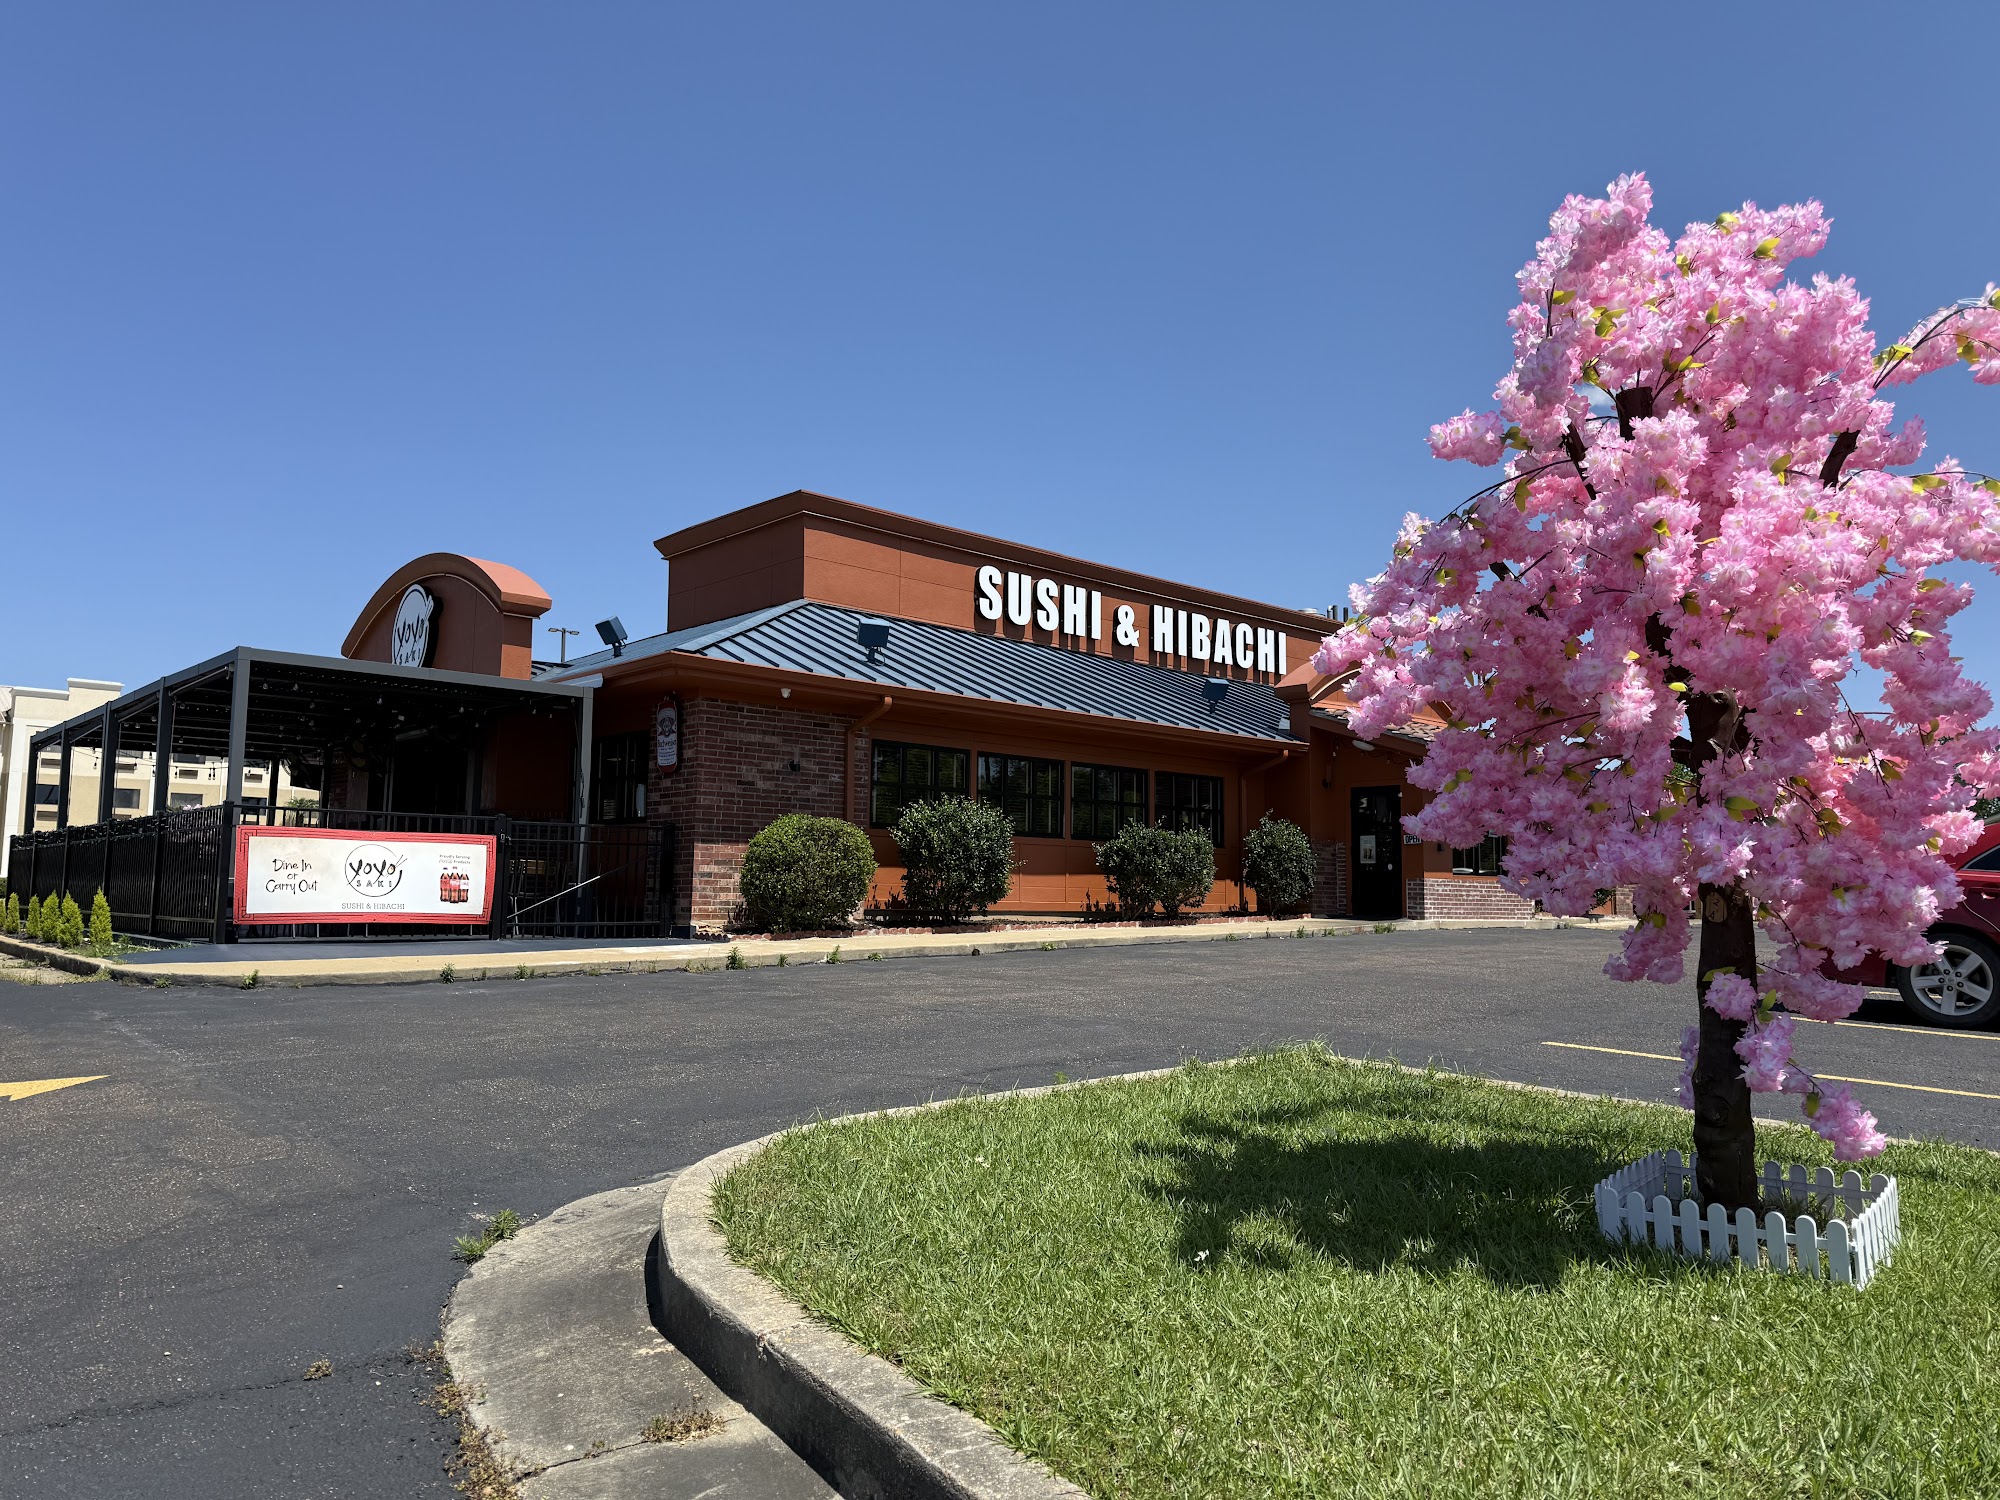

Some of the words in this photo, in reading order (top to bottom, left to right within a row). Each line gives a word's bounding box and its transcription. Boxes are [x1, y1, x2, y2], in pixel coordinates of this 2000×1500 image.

[977, 565, 1102, 640] SUSHI
[1115, 604, 1140, 648] &
[1152, 604, 1287, 676] HIBACHI
[399, 648, 421, 665] SAKI
[272, 858, 299, 872] Dine
[301, 859, 312, 872] In
[265, 879, 296, 895] Carry
[298, 879, 319, 893] Out
[356, 879, 393, 888] SAKI
[341, 902, 365, 910] SUSHI
[365, 902, 372, 910] &
[373, 902, 405, 910] HIBACHI
